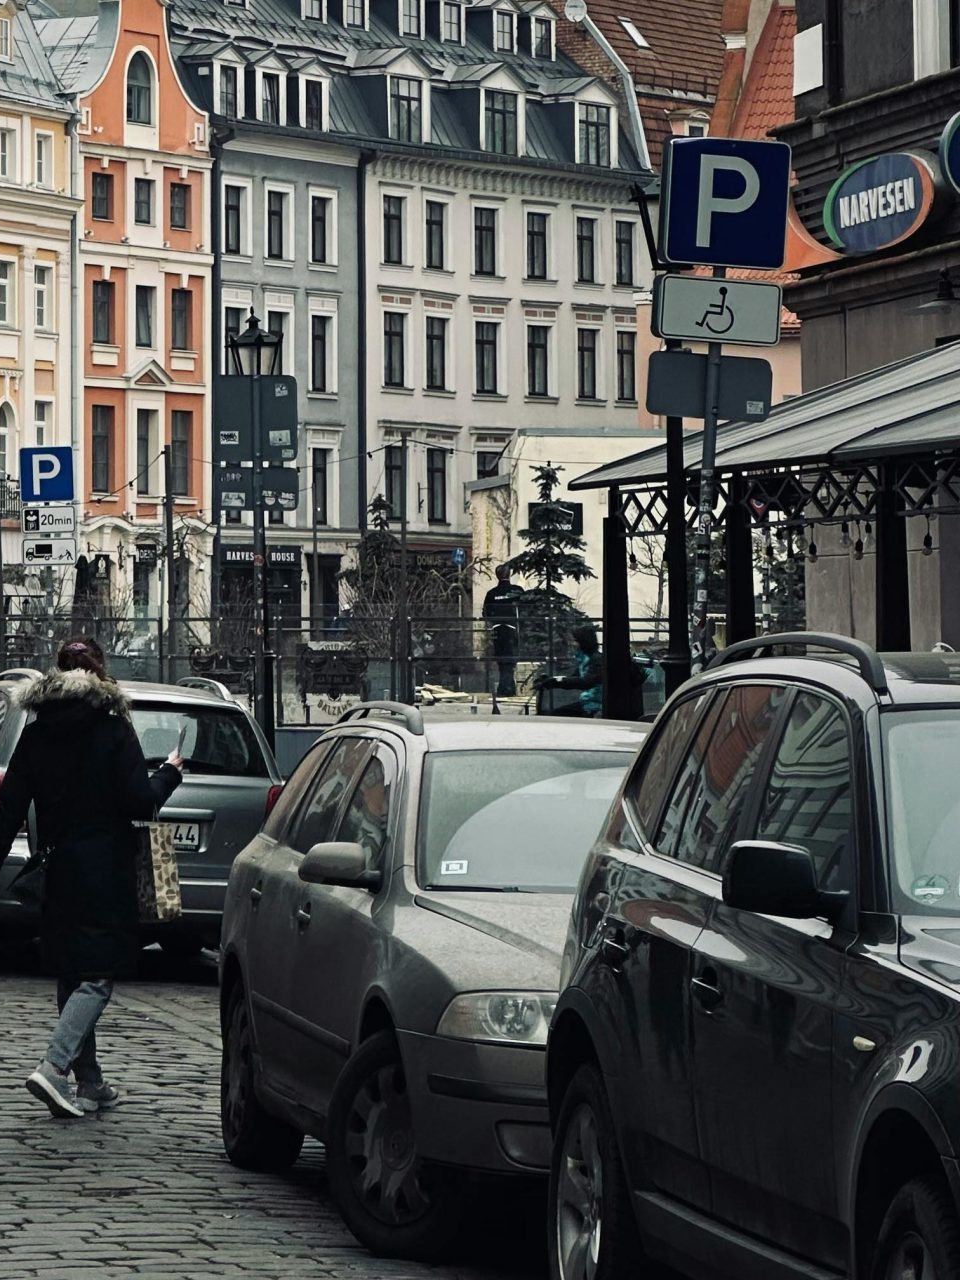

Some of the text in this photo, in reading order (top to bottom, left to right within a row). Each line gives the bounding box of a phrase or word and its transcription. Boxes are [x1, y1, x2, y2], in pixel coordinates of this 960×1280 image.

[696, 153, 760, 247] P
[840, 177, 915, 228] NARVESEN
[32, 453, 61, 495] P
[226, 551, 295, 562] HARVES HOUSE
